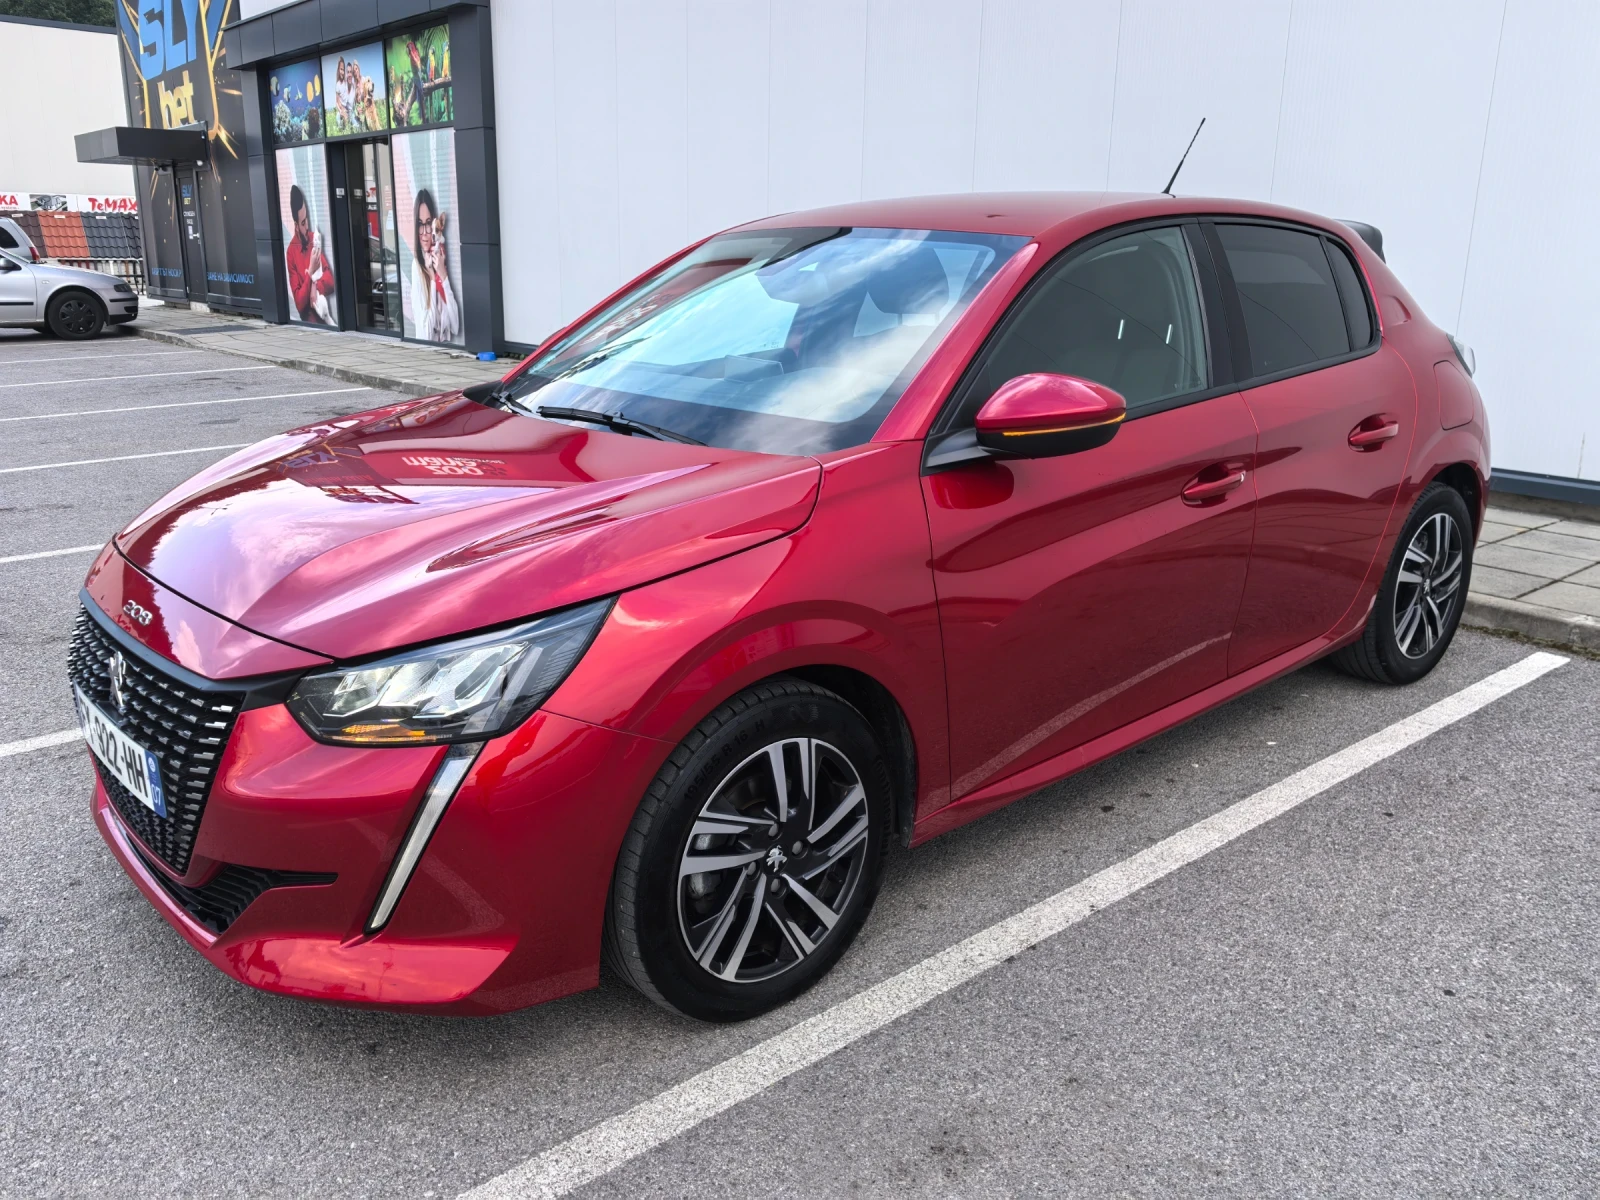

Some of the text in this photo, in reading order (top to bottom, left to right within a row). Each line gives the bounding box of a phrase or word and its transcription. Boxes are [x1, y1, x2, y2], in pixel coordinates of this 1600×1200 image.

[138, 0, 199, 80] SLY
[157, 70, 196, 129] bet
[123, 599, 153, 626] 208
[734, 730, 749, 745] 16
